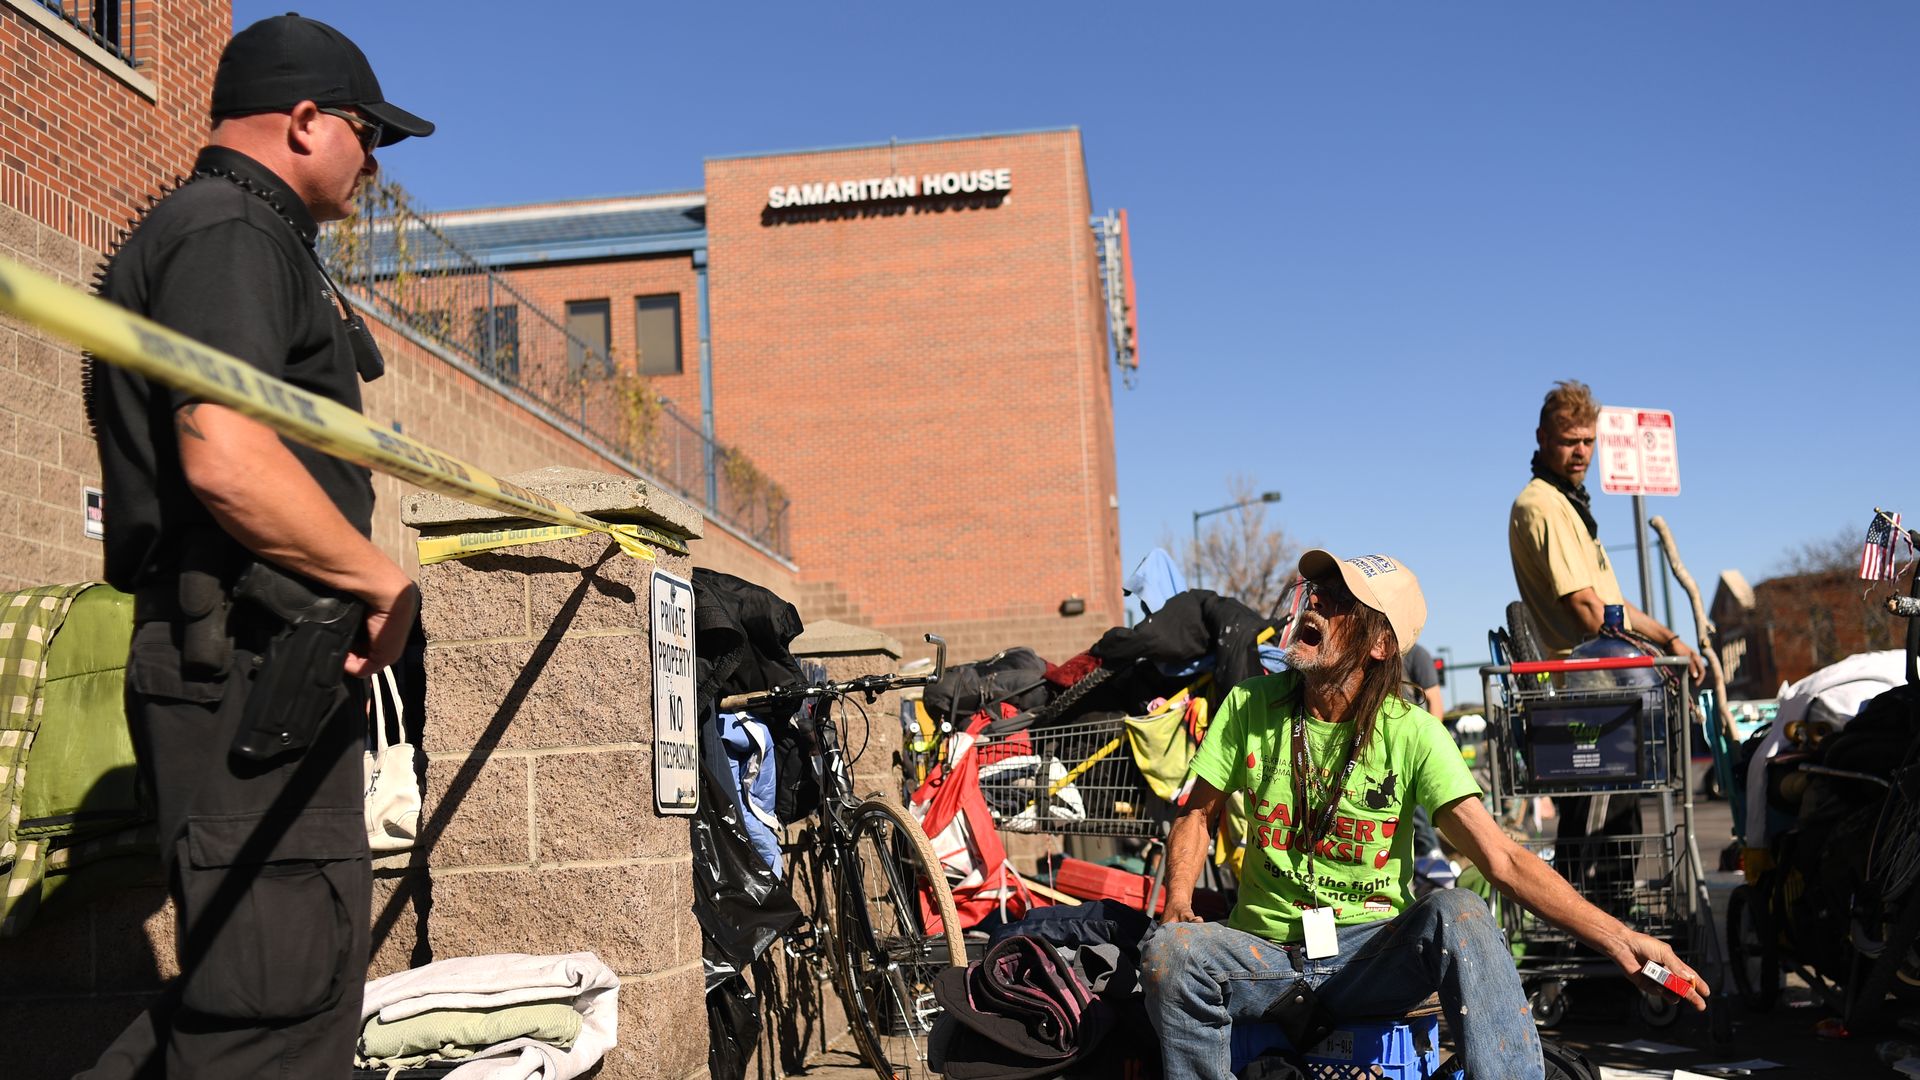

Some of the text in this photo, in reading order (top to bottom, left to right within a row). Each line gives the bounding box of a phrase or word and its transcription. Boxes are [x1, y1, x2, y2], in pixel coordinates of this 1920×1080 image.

[768, 168, 1012, 208] SAMARITAN HOUSE
[660, 600, 687, 638] PRIVATE
[658, 640, 691, 678] PROPERTY
[669, 694, 684, 732] NO
[659, 740, 695, 771] TRESPASSING
[1254, 799, 1376, 842] CANER
[1257, 825, 1366, 865] SUCKS!
[1318, 875, 1347, 888] the
[1351, 876, 1391, 895] fight
